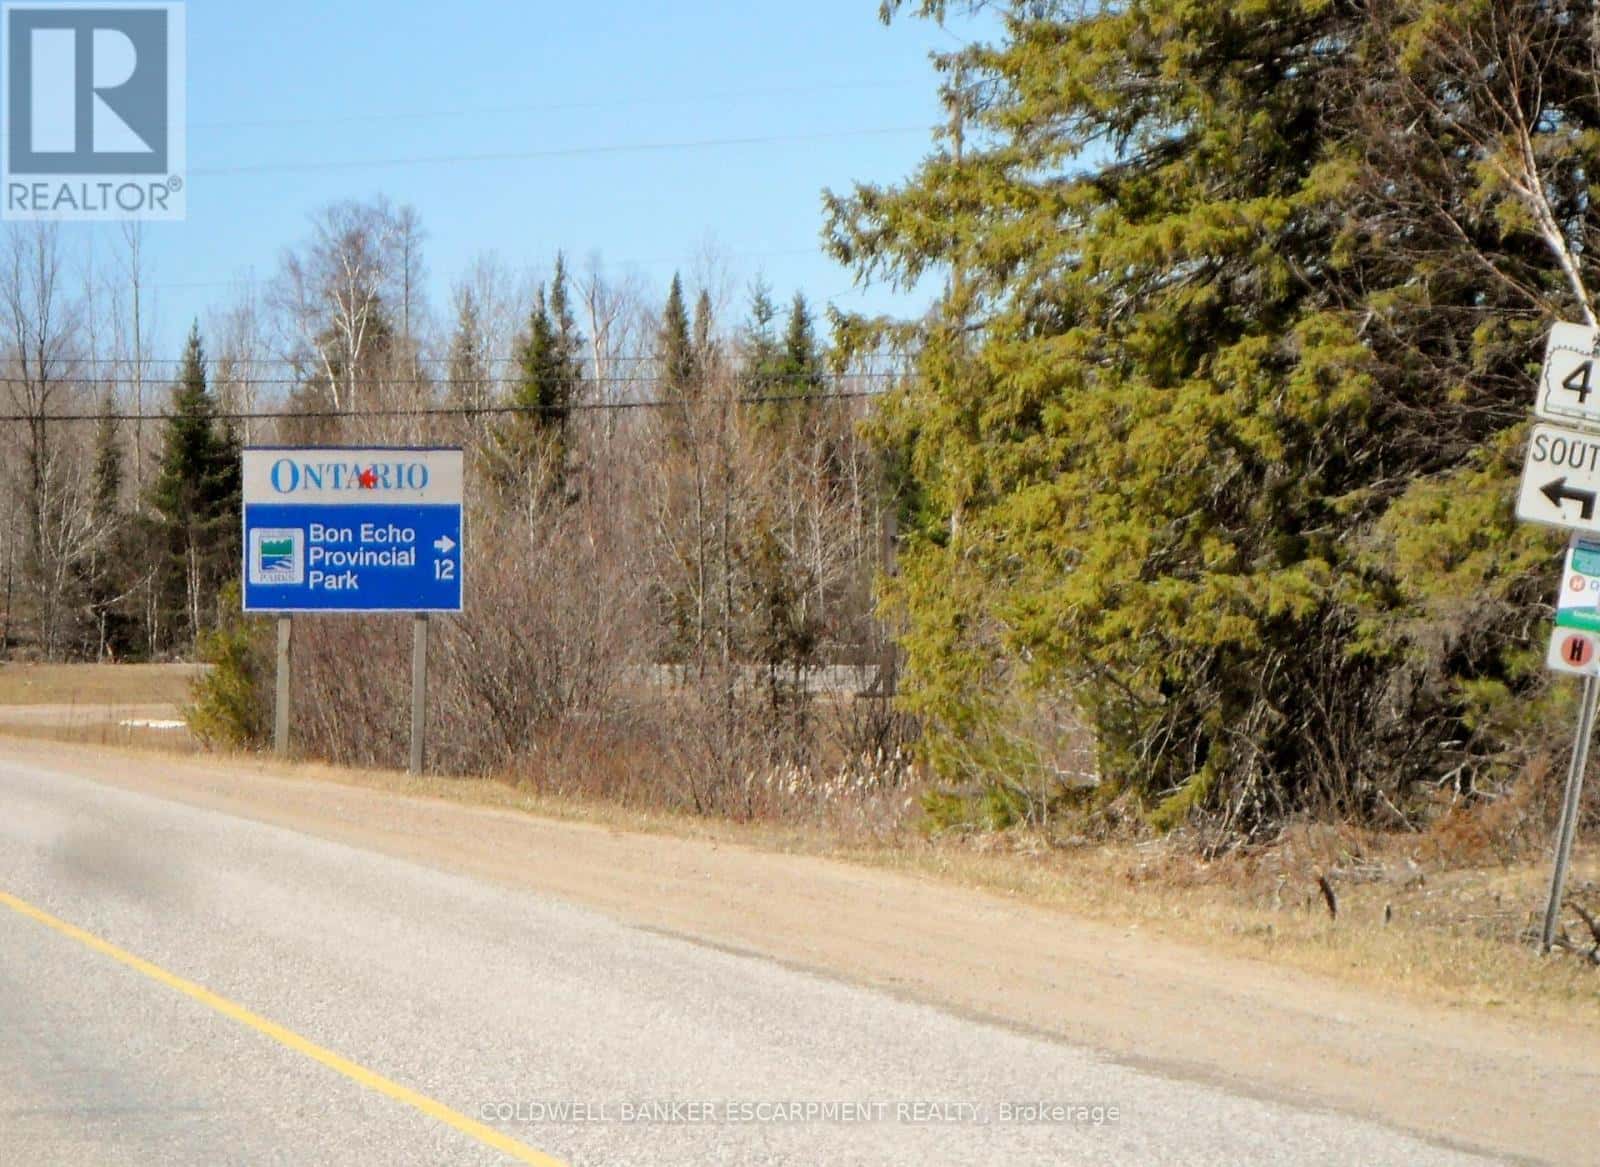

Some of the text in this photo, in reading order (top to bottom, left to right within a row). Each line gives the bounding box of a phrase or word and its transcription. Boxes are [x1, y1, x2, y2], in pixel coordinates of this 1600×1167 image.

[270, 458, 429, 493] ONTARIO
[309, 523, 415, 543] Bon Echo
[309, 547, 415, 566] Provincial
[433, 559, 454, 580] 12
[309, 571, 359, 590] Park
[1570, 638, 1584, 661] H
